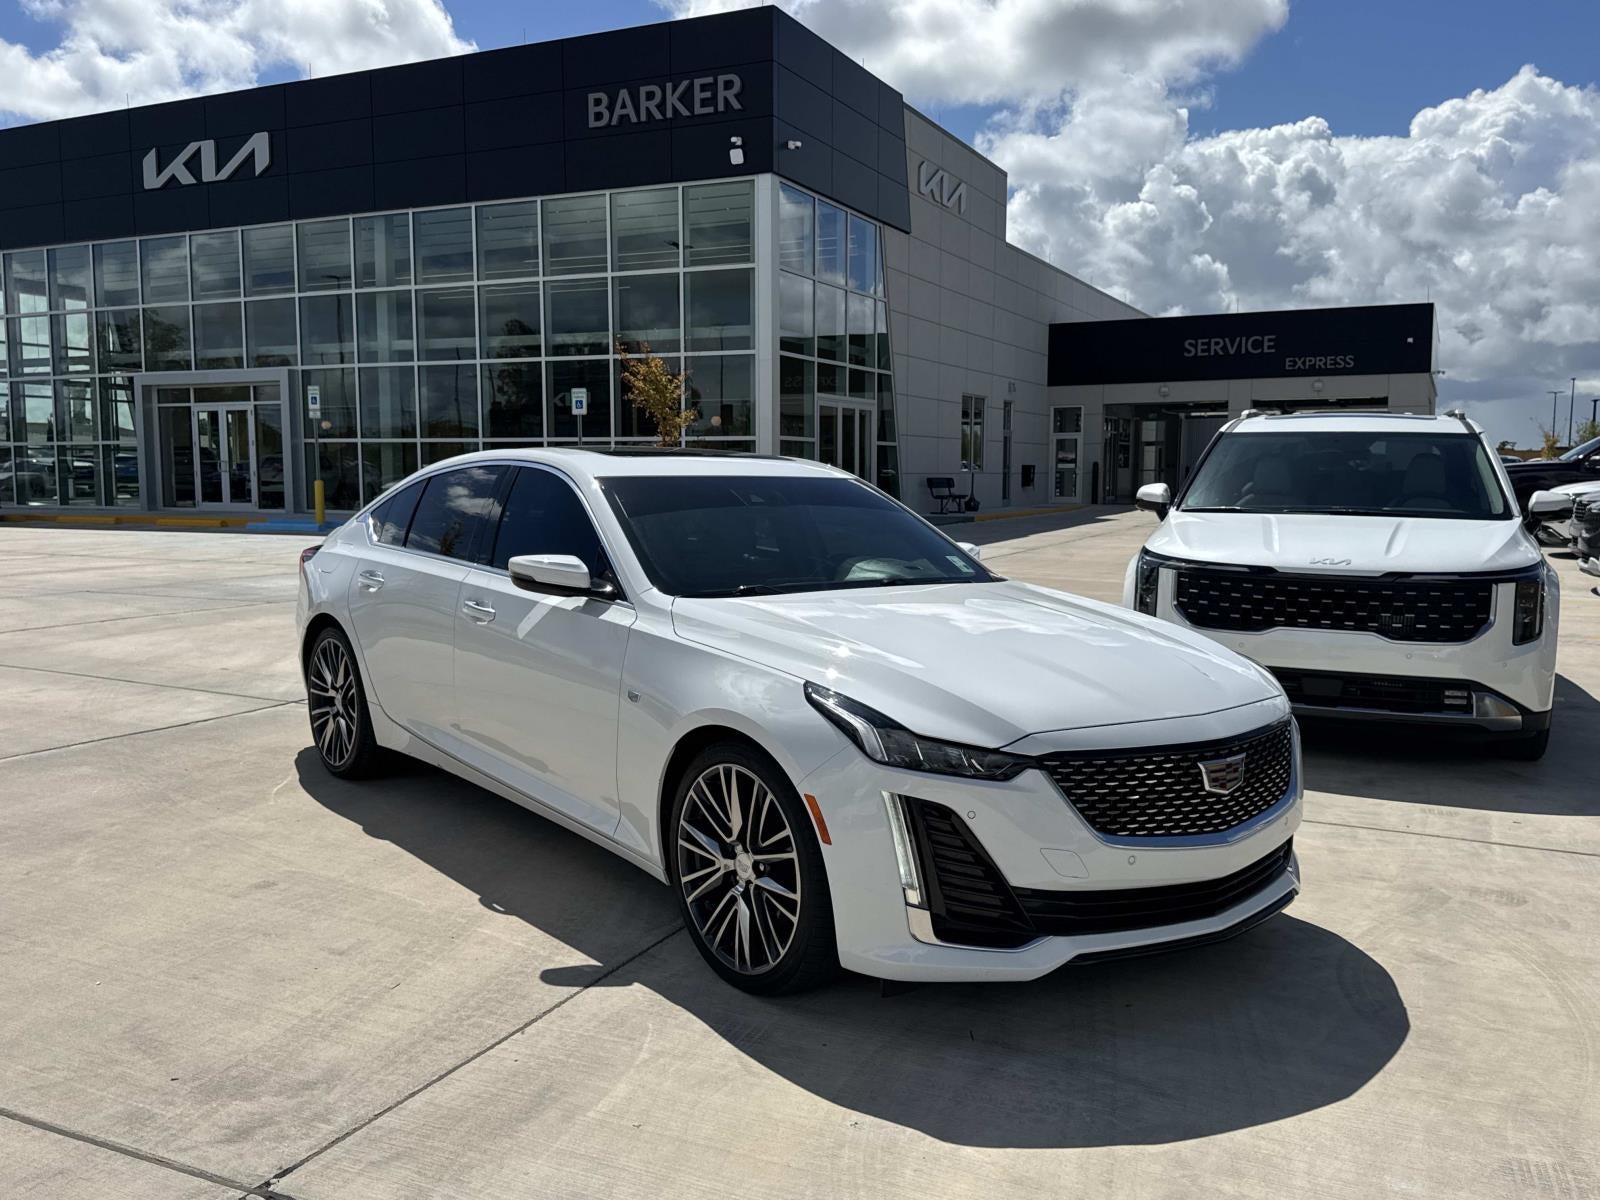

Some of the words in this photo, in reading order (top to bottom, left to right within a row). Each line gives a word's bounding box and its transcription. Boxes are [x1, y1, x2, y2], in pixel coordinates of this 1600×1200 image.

[587, 73, 743, 129] BARKER
[142, 131, 270, 190] KIA
[918, 160, 967, 214] KIA
[1183, 335, 1277, 357] SERVICE
[1285, 355, 1355, 370] EXPRESS
